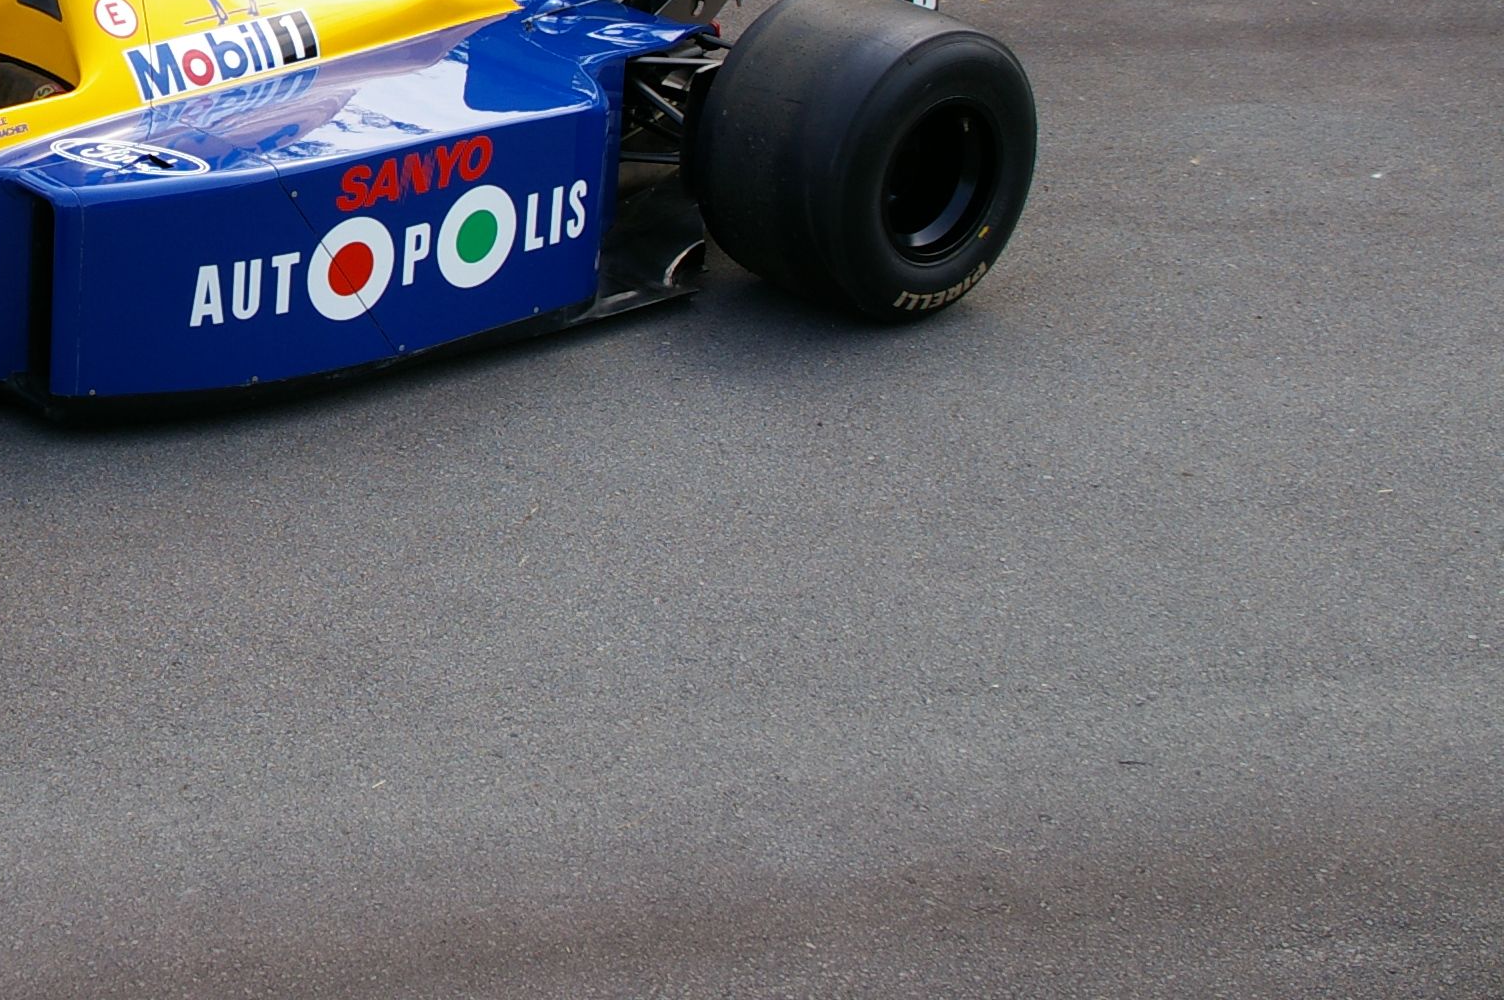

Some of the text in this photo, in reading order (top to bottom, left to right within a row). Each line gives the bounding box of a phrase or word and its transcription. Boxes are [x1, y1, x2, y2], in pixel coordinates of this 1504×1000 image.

[105, 2, 126, 25] E
[127, 16, 308, 101] Mobil 1
[335, 135, 494, 212] SANYO
[189, 178, 588, 327] AUTOPOLIS
[892, 262, 988, 311] PIRELLI
